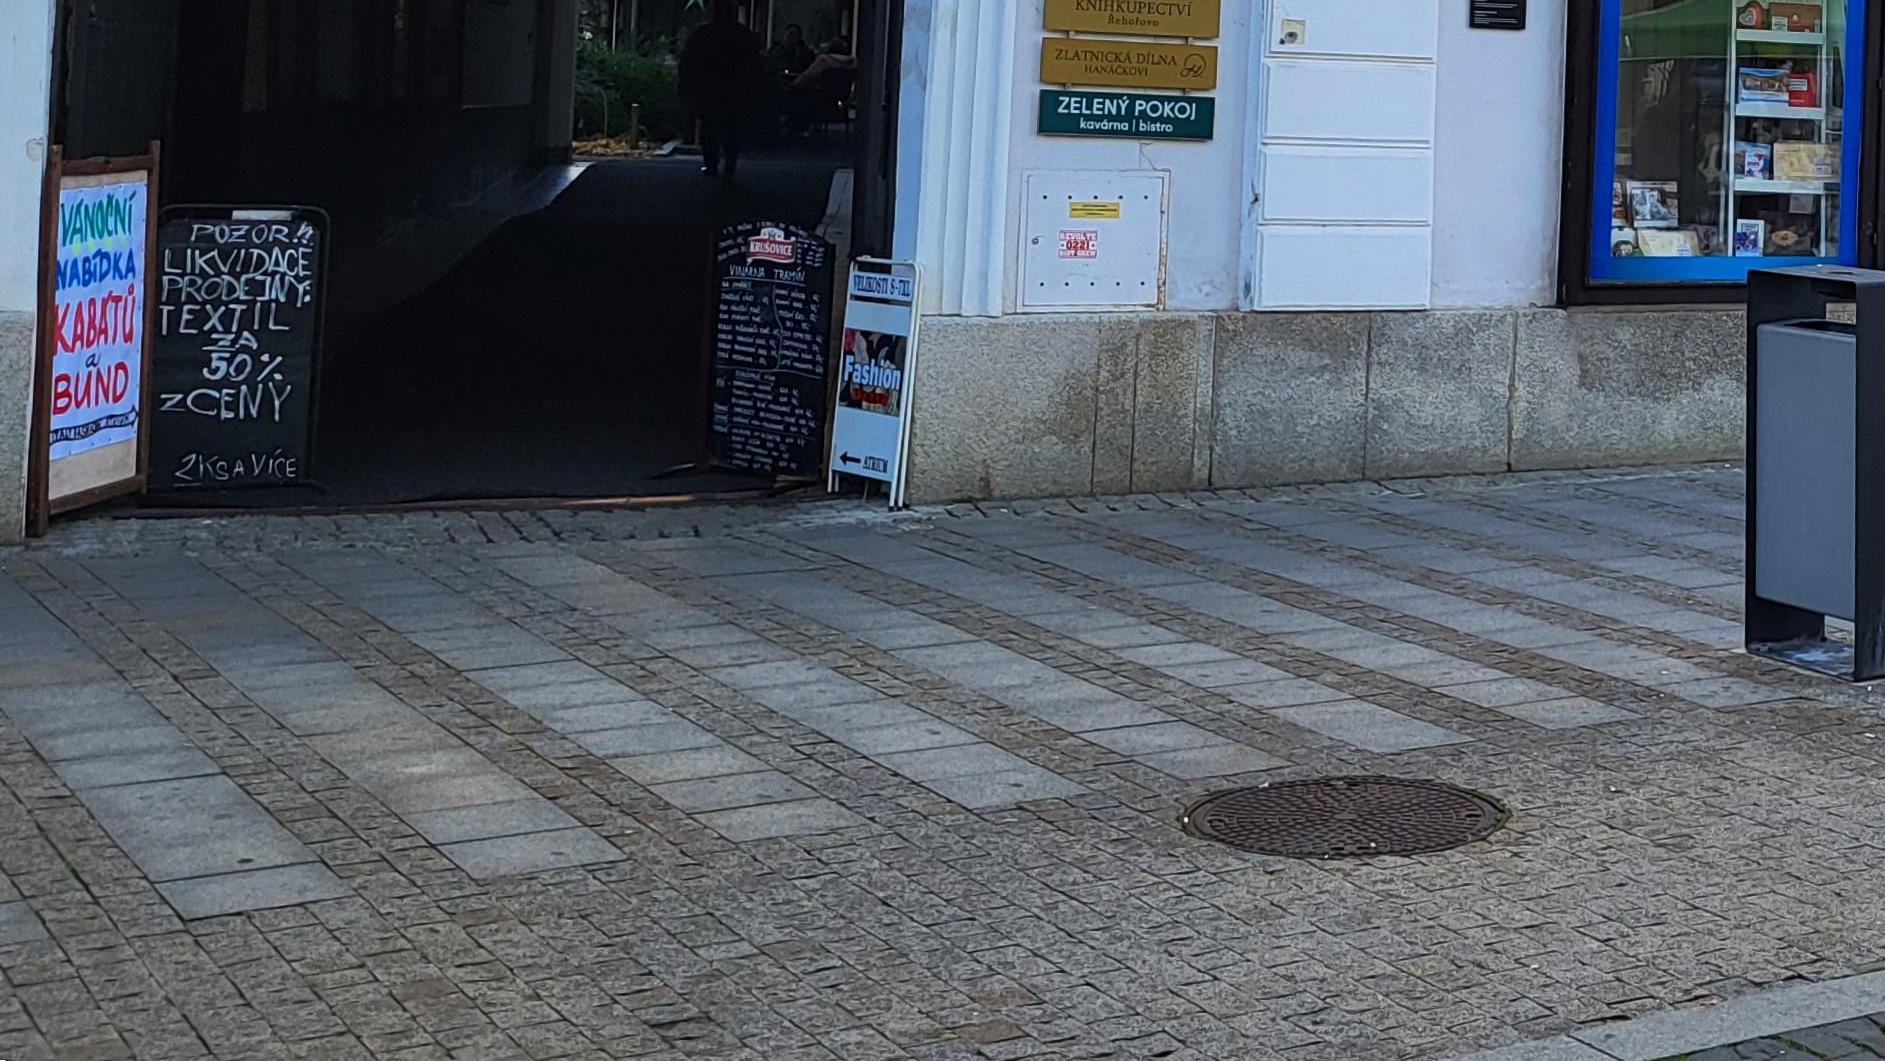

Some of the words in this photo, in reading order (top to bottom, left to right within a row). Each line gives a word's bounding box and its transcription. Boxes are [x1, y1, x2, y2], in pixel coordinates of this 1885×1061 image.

[1055, 49, 1132, 65] ZLATNICKÁ
[1136, 52, 1178, 67] DÍLNA
[1084, 64, 1149, 77] HANÁČKOVI
[1057, 95, 1130, 116] ZELENÝ
[1134, 100, 1197, 120] POKOJ
[1079, 117, 1130, 131] kavárna
[1138, 120, 1174, 133] bistro
[60, 190, 137, 247] VÁNOČNÍ
[749, 241, 793, 257] KRUŠOVICE
[55, 247, 136, 291] NABÍDKA
[164, 246, 313, 277] LIKVIDACE
[52, 283, 136, 356] KABÁTŮ
[158, 302, 290, 335] TEXTIL
[201, 330, 258, 351] ZA
[85, 353, 100, 368] a
[844, 354, 902, 391] Fashion
[862, 455, 888, 474] ATRIUM
